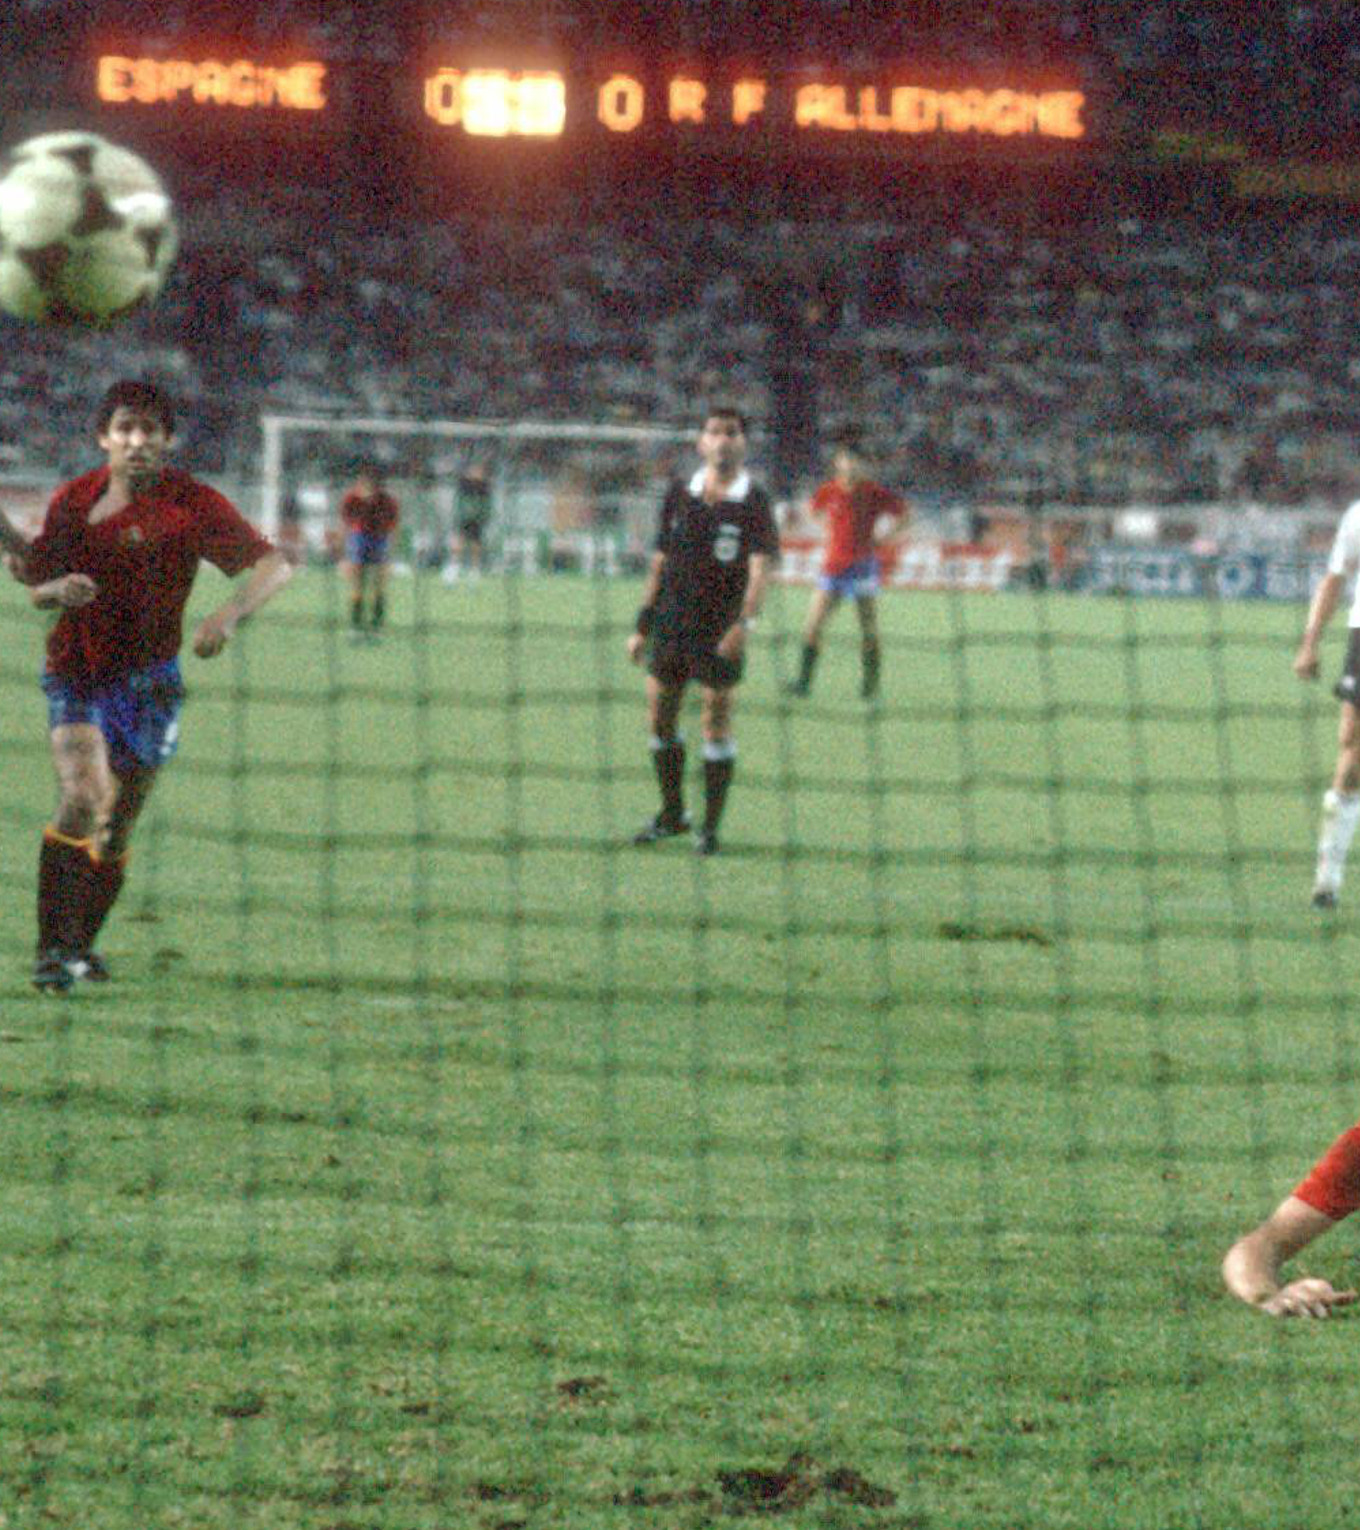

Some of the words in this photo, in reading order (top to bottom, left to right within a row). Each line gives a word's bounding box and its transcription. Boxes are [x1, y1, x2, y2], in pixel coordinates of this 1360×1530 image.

[98, 55, 327, 109] ESPAGNE
[669, 76, 706, 123] R
[732, 80, 766, 125] F
[795, 83, 1085, 138] ALLEMAGNE
